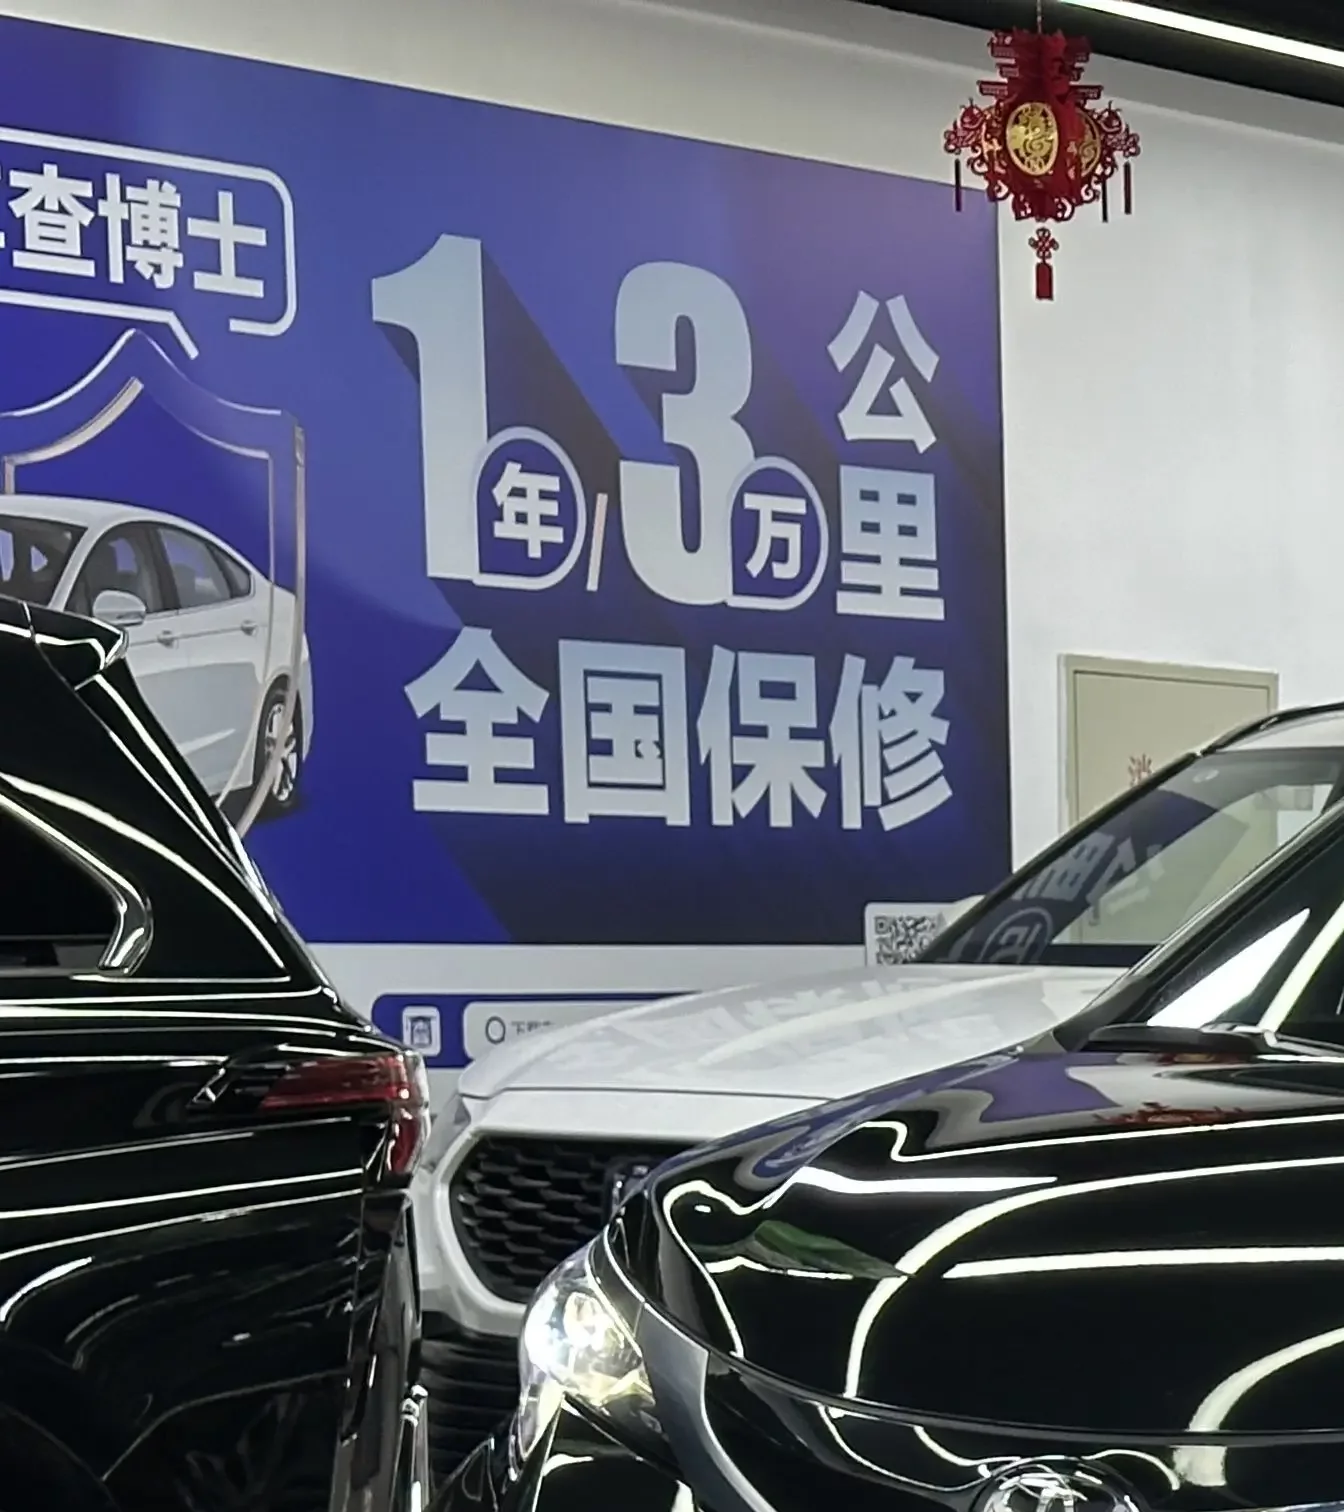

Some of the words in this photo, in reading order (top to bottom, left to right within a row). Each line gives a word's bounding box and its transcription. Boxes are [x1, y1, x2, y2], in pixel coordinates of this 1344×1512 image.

[0, 163, 267, 298] 查博士
[404, 626, 953, 832] 全国保修
